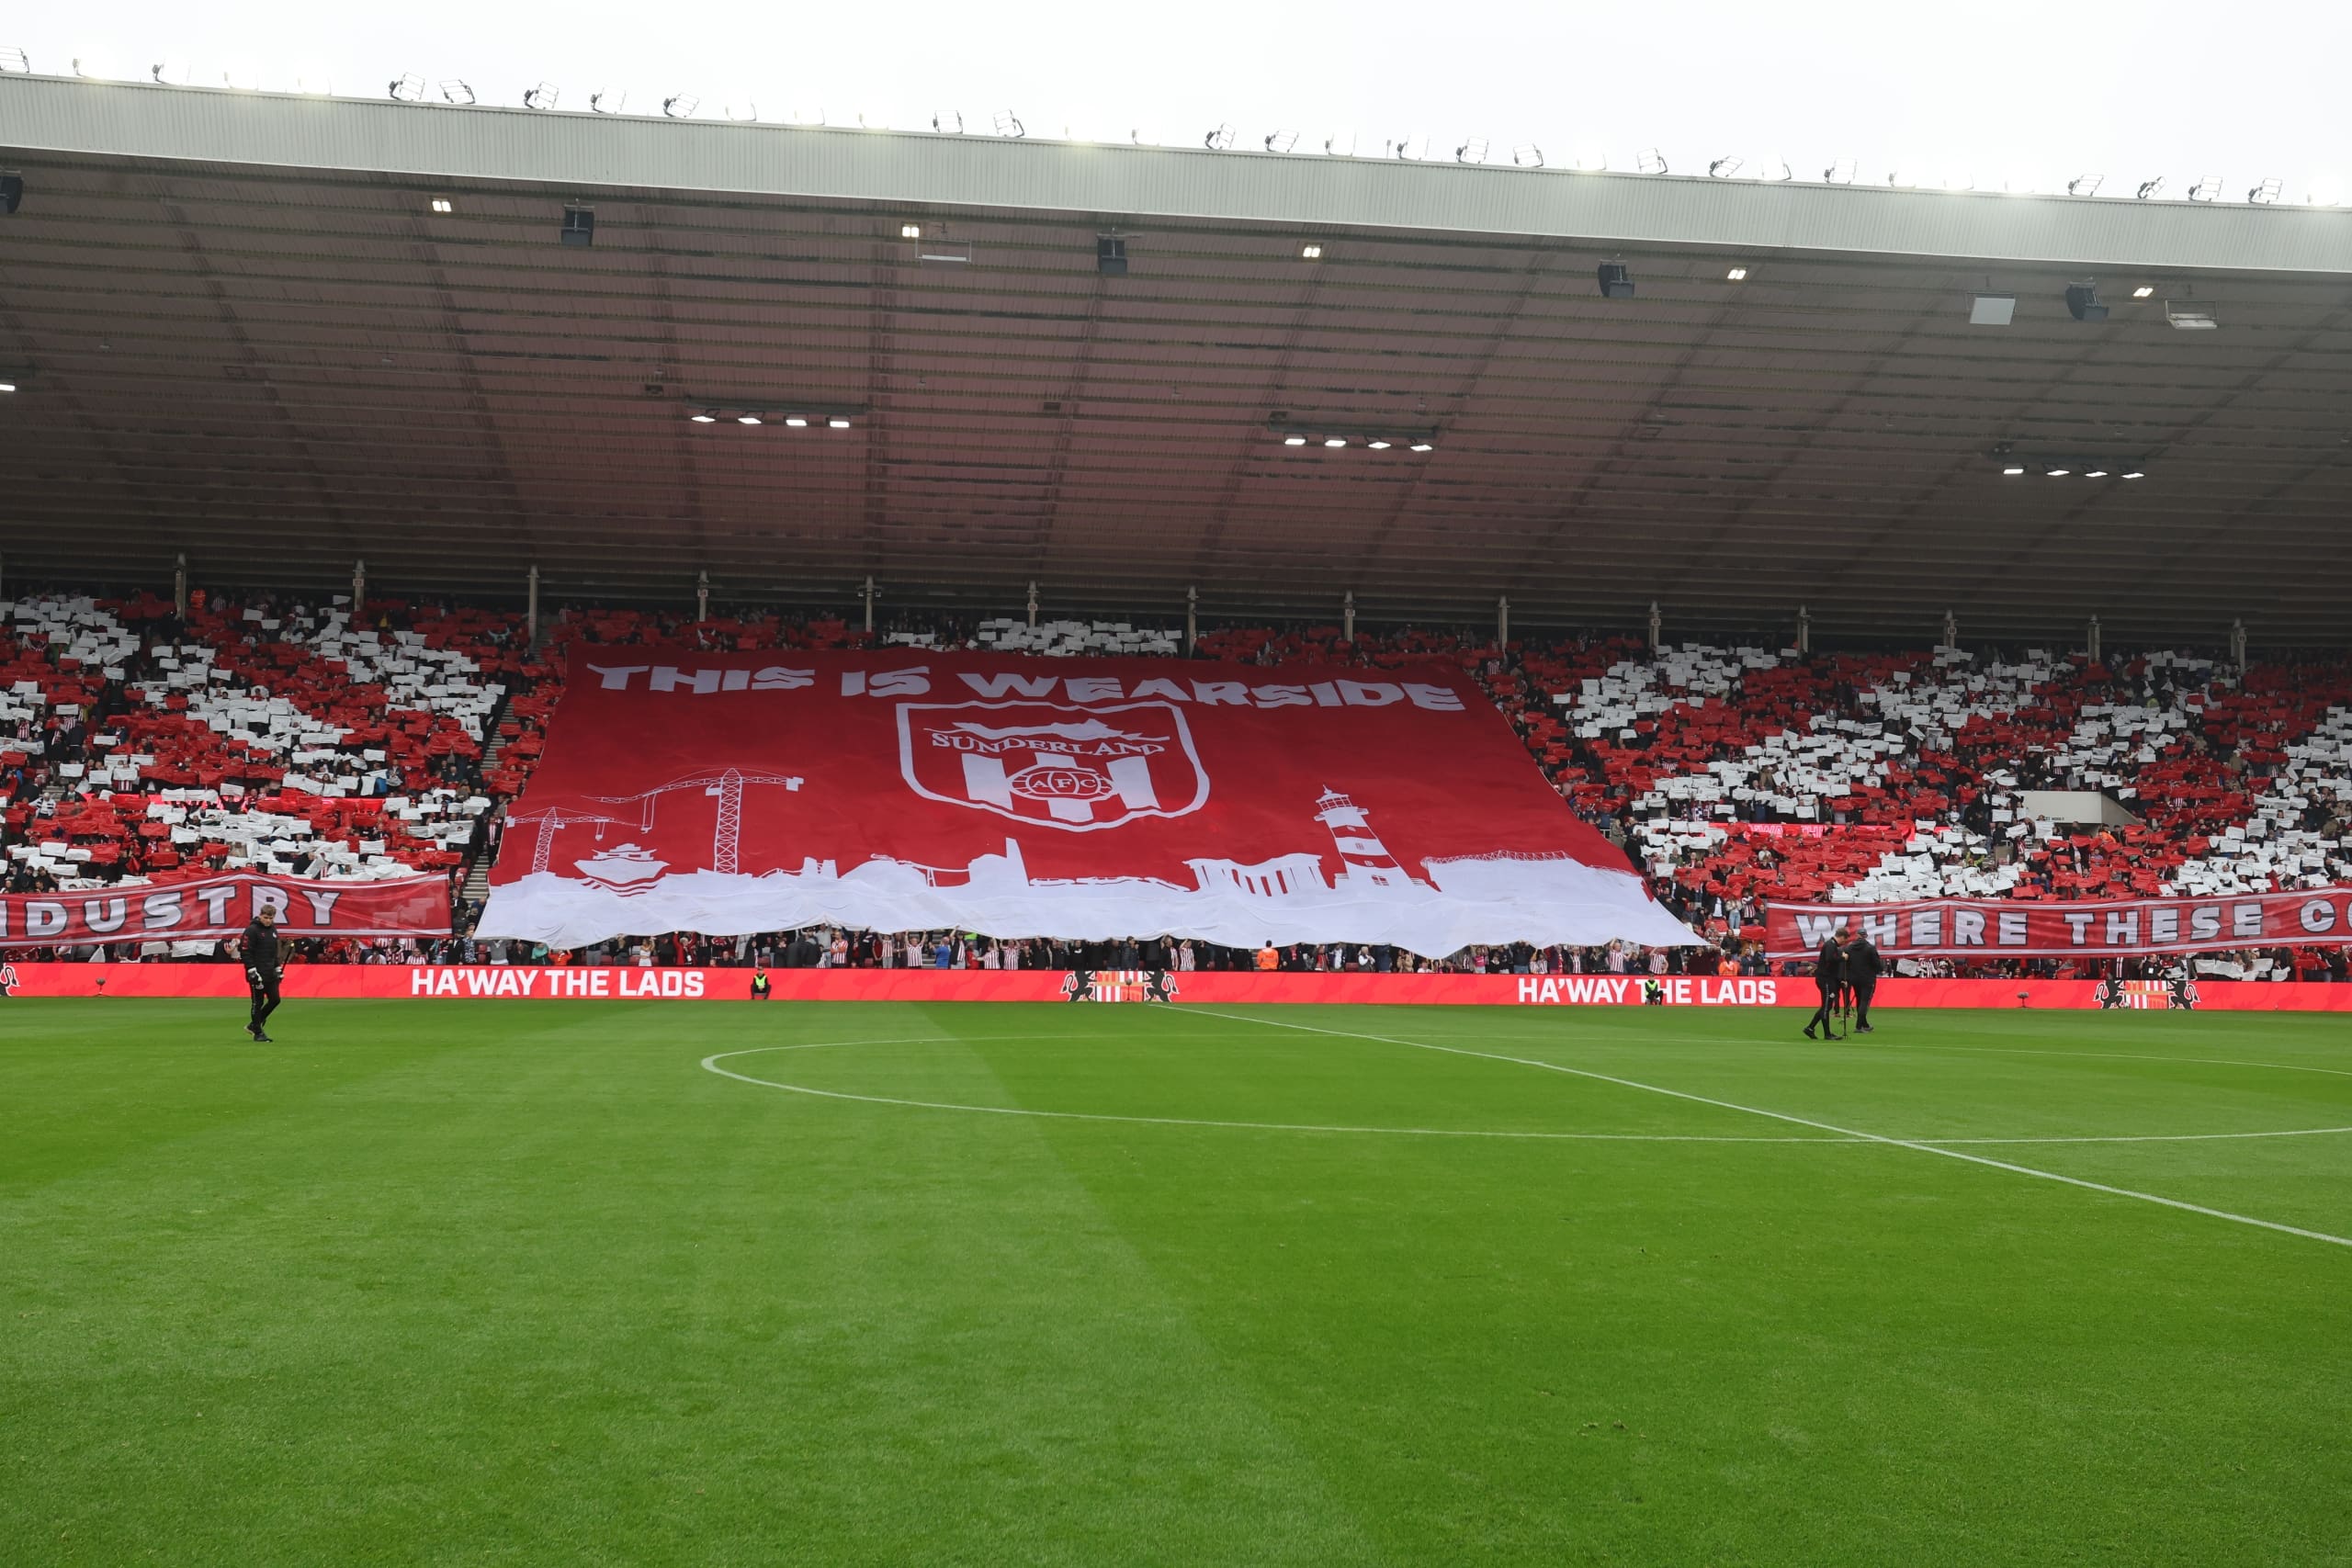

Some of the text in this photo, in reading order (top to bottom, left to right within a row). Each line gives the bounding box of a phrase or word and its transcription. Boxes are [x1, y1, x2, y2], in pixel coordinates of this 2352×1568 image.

[587, 663, 1464, 711] THIS IS WEARSIDE
[933, 733, 1165, 756] SUNDERLAND
[1032, 778, 1097, 789] AFC
[0, 886, 340, 936] DUSTRY
[1795, 899, 2352, 949] WHERE THESE C
[545, 969, 610, 996] THE
[619, 970, 704, 997] LADS
[1701, 979, 1777, 1004] LADS
